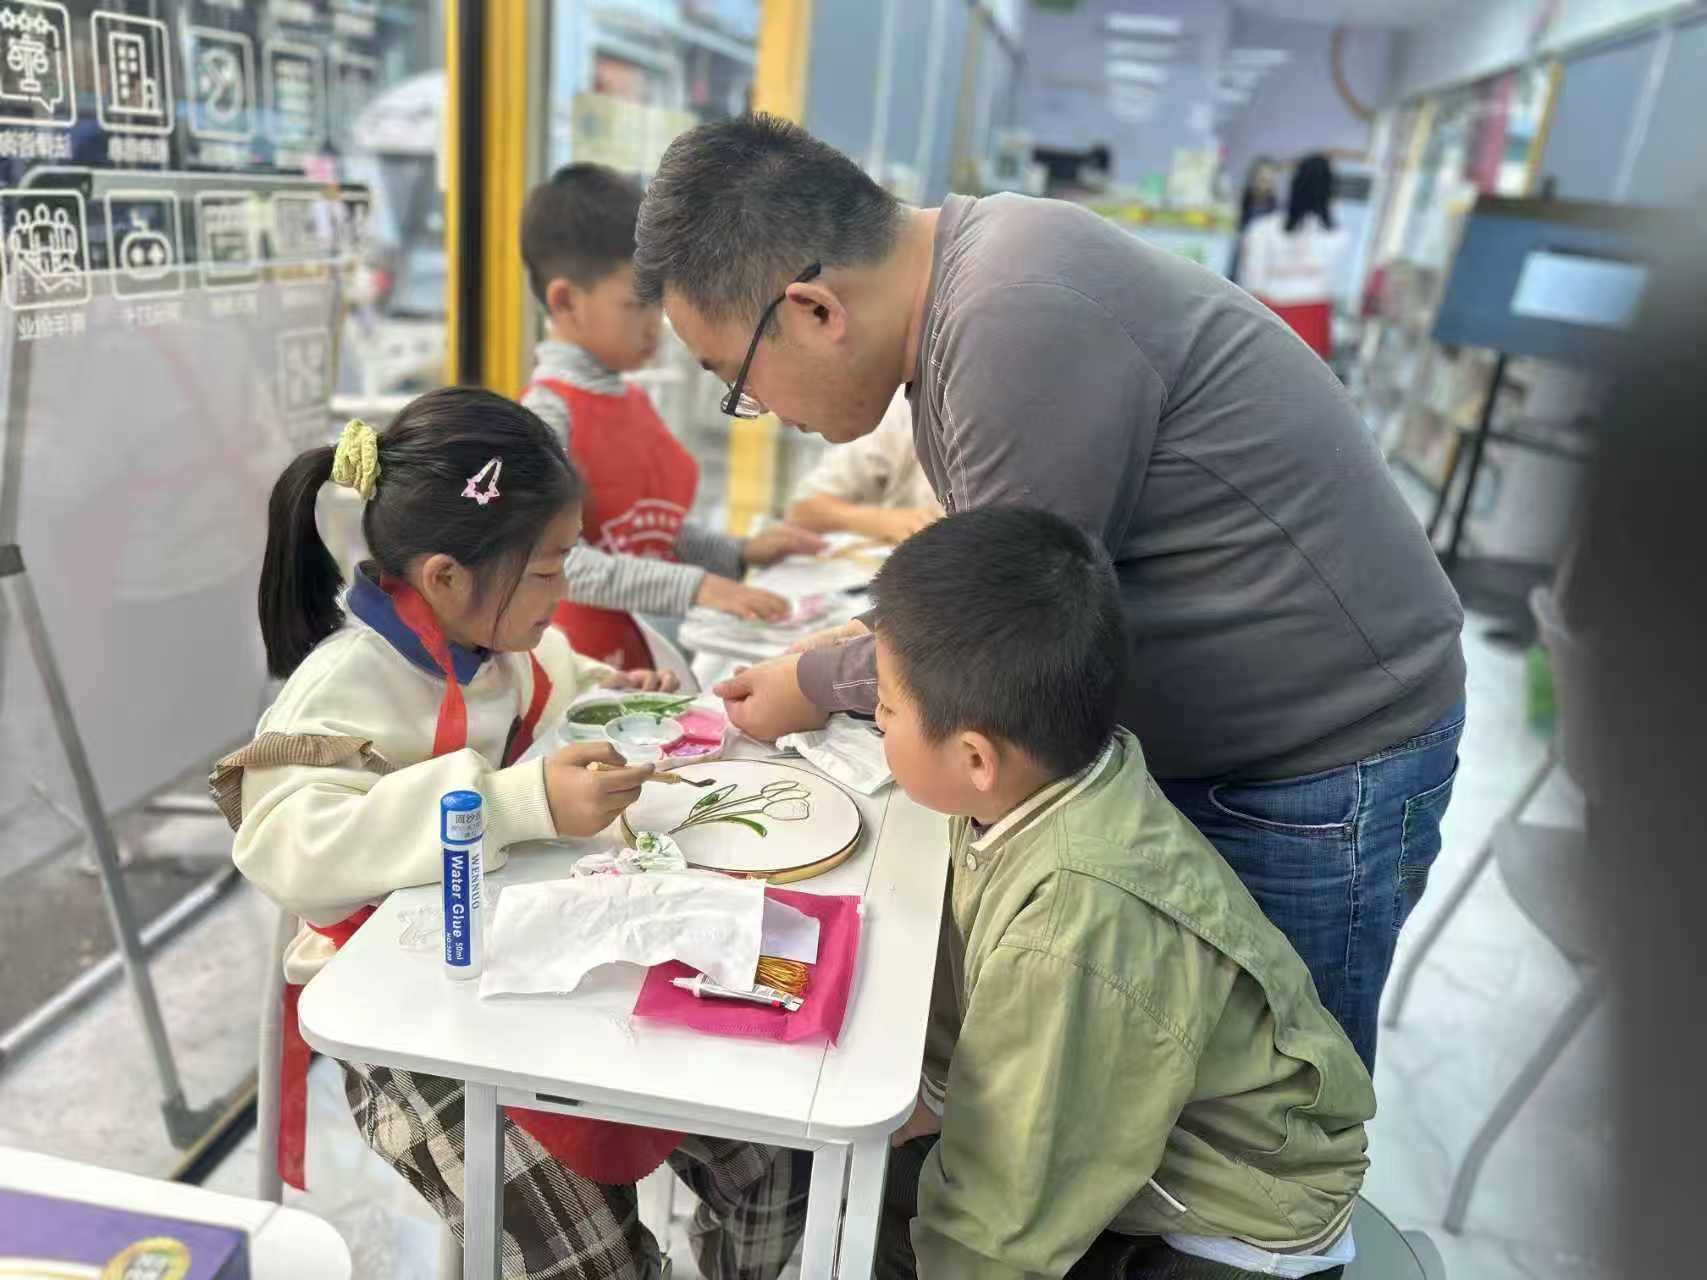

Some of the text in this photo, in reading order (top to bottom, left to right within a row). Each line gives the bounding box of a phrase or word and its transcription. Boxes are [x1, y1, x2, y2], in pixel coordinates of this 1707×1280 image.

[451, 855, 465, 960] Water Glue 50ml
